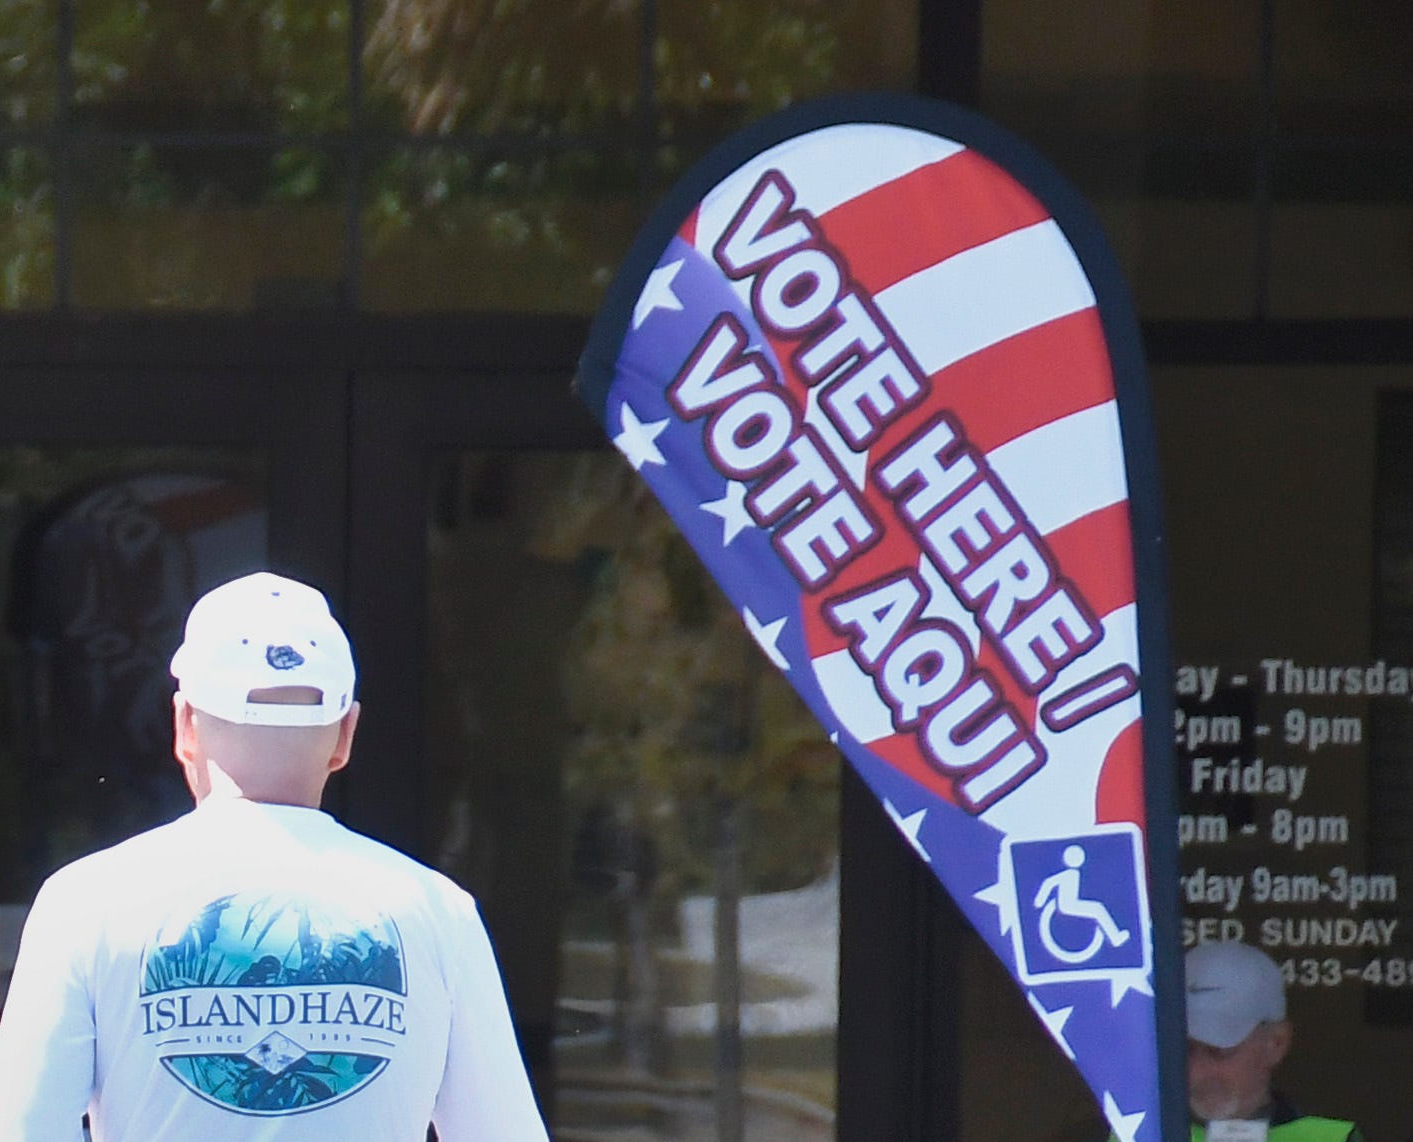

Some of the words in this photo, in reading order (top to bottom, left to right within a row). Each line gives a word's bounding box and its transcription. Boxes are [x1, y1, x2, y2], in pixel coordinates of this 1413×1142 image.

[711, 168, 931, 451] VOTE
[875, 408, 1104, 693] HERE
[667, 312, 884, 588] VOTE
[822, 566, 1049, 816] AQUI
[1260, 659, 1413, 696] Thursda
[1284, 708, 1362, 752] 9pm
[1190, 757, 1307, 800] Friday
[1271, 808, 1349, 850] 8pm
[1251, 866, 1398, 910] 9am-3pm
[1260, 918, 1399, 947] SUNDAY
[1282, 958, 1413, 986] 433-48
[141, 992, 407, 1035] ISLANDHAZE
[196, 1034, 243, 1044] SINCE
